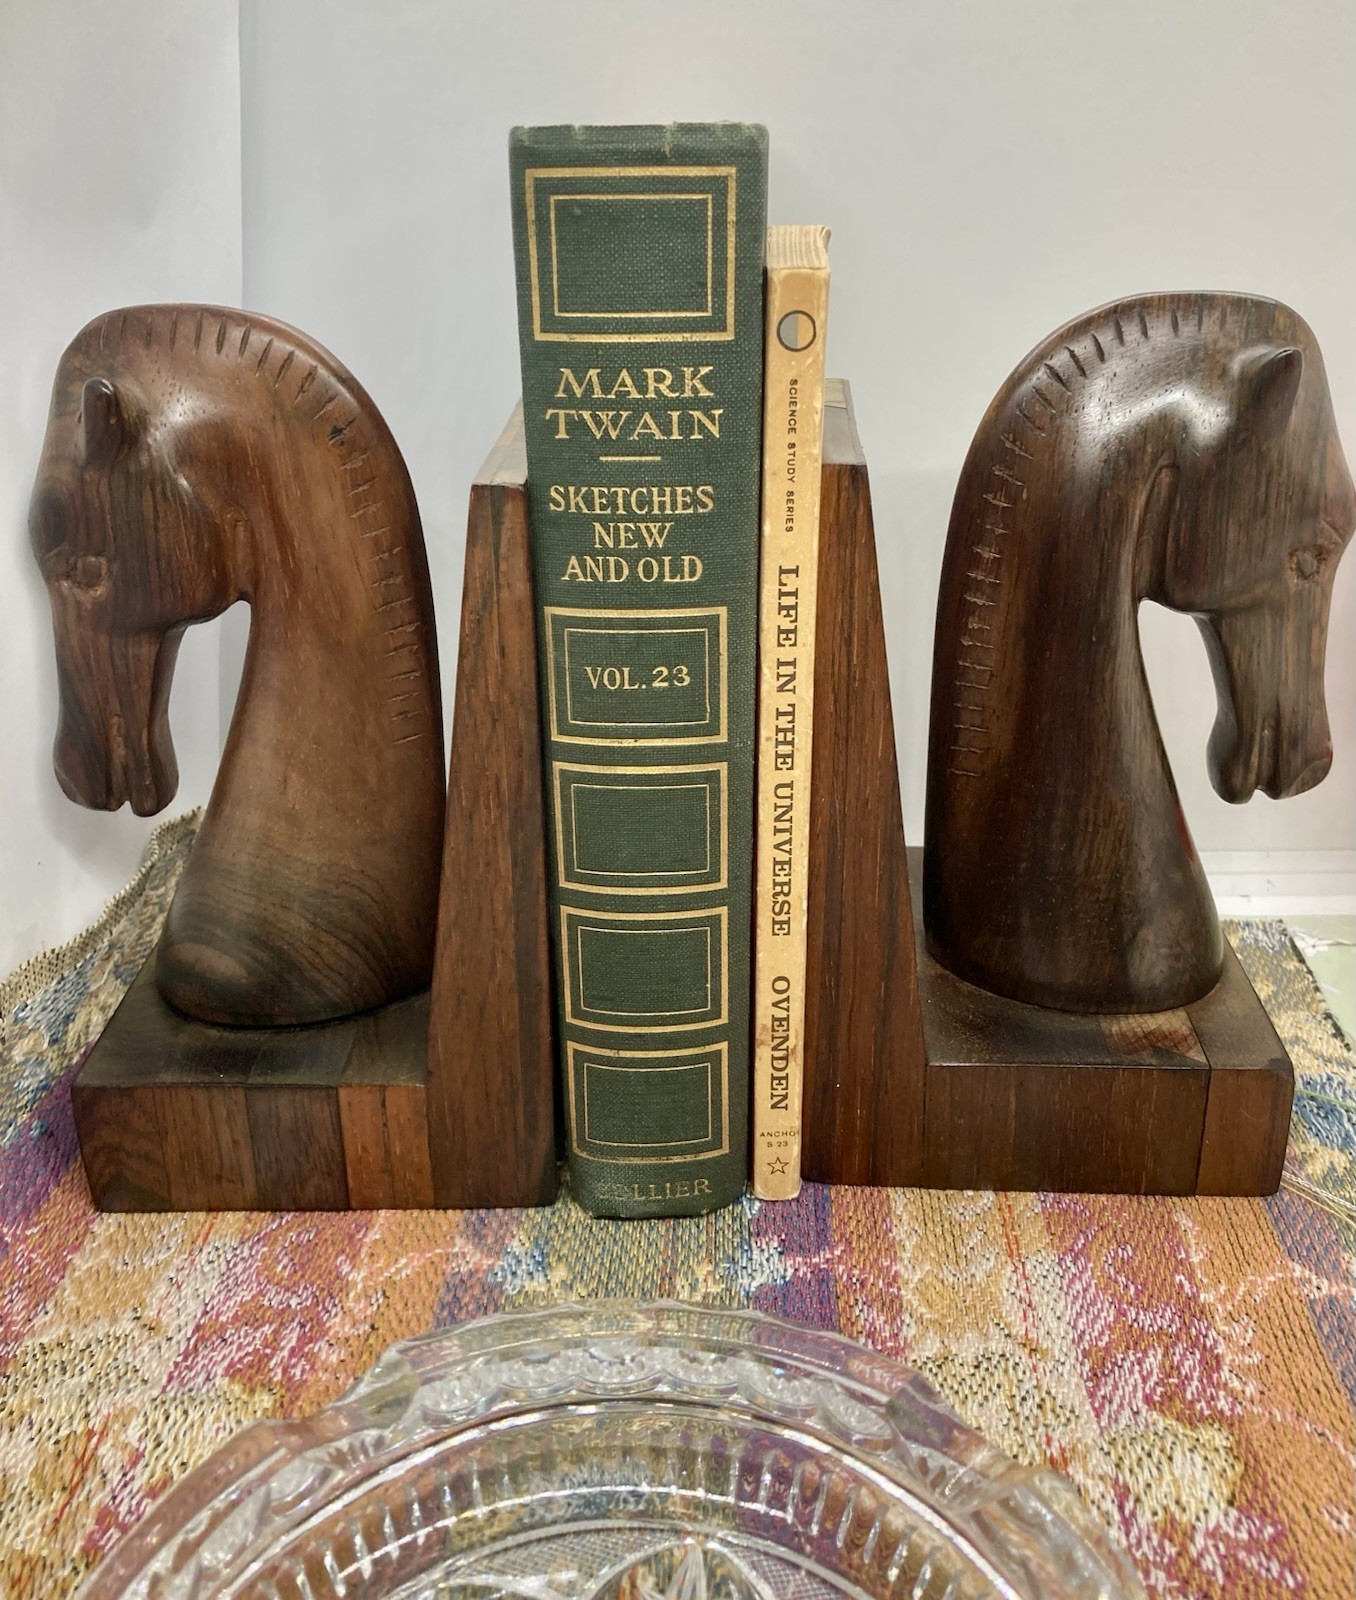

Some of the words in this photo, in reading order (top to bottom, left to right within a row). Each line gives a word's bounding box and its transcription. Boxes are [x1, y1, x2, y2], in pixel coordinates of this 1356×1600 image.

[554, 365, 715, 400] MARK
[545, 408, 725, 441] TWAIN
[787, 378, 798, 435] SCIENCE
[786, 442, 796, 484] STUDY
[549, 484, 715, 515] SKETCHES
[785, 490, 795, 533] SERIES
[592, 521, 675, 549] NEW
[561, 555, 629, 583] AND
[637, 554, 704, 583] OLD
[777, 565, 800, 648] LIFE
[776, 657, 798, 695] IN
[774, 703, 796, 771] THE
[771, 780, 794, 937] UNIVERSE
[770, 975, 791, 1111] OVENDEN
[760, 1130, 800, 1138] ANCHO
[766, 1140, 773, 1148] S
[776, 1140, 788, 1148] 23
